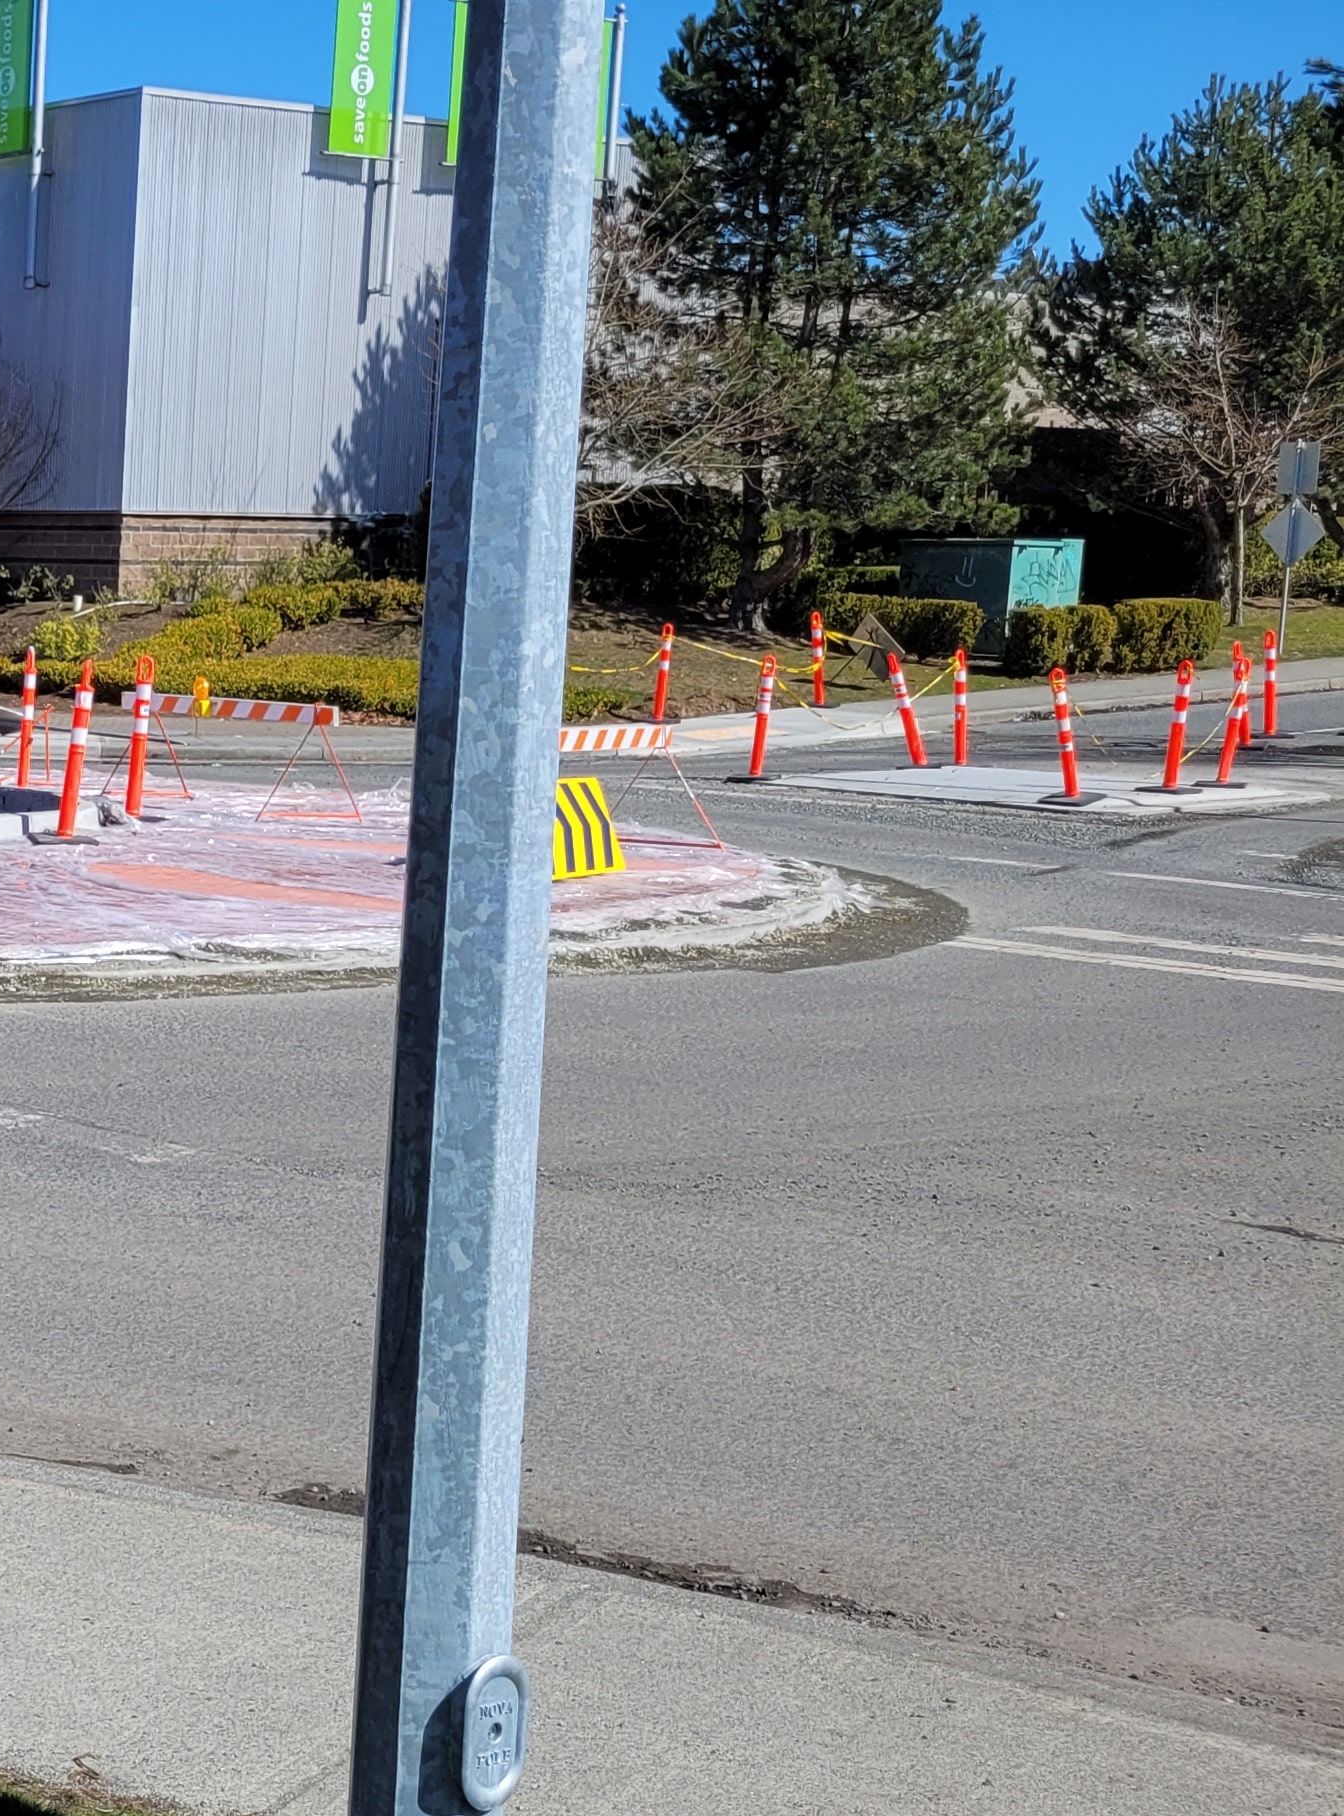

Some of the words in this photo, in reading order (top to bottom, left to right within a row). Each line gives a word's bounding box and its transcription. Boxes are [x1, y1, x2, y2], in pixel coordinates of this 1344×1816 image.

[0, 3, 13, 64] foods
[356, 1, 373, 62] foods
[1, 69, 11, 92] on
[356, 67, 368, 94] on
[0, 100, 9, 144] save
[354, 97, 367, 144] save
[479, 1701, 513, 1720] NOVA
[476, 1749, 512, 1769] POLE
